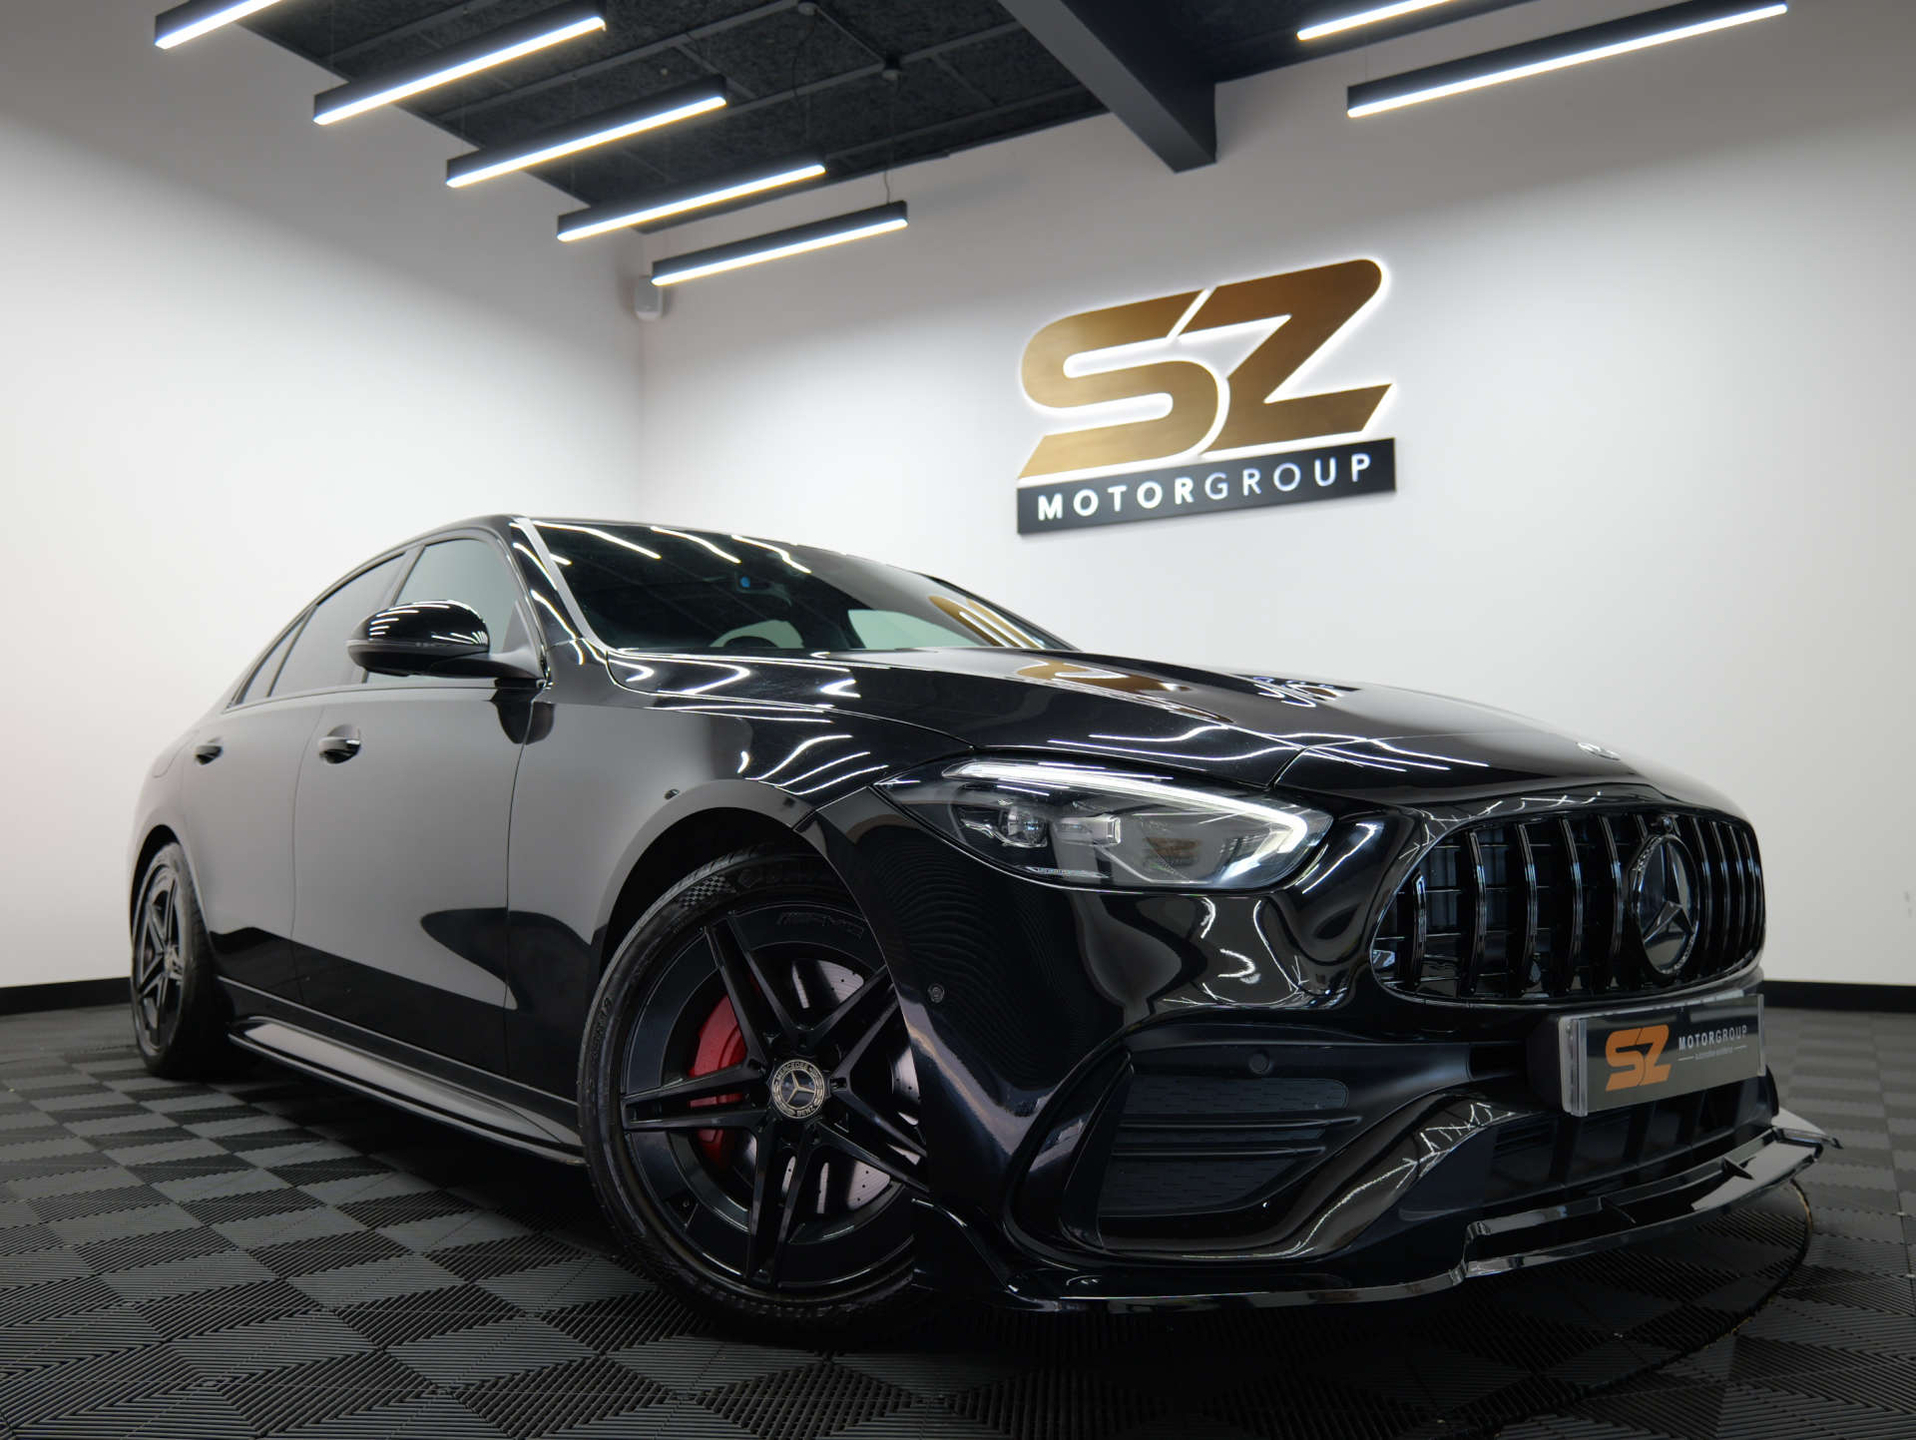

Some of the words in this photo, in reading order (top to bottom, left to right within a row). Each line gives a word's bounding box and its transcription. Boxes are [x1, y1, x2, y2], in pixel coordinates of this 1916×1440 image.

[1017, 258, 1393, 480] SZ
[1036, 453, 1372, 521] MOTORGROUP
[1605, 1024, 1672, 1092] SZ
[1678, 1024, 1748, 1051] MOTORGROUP
